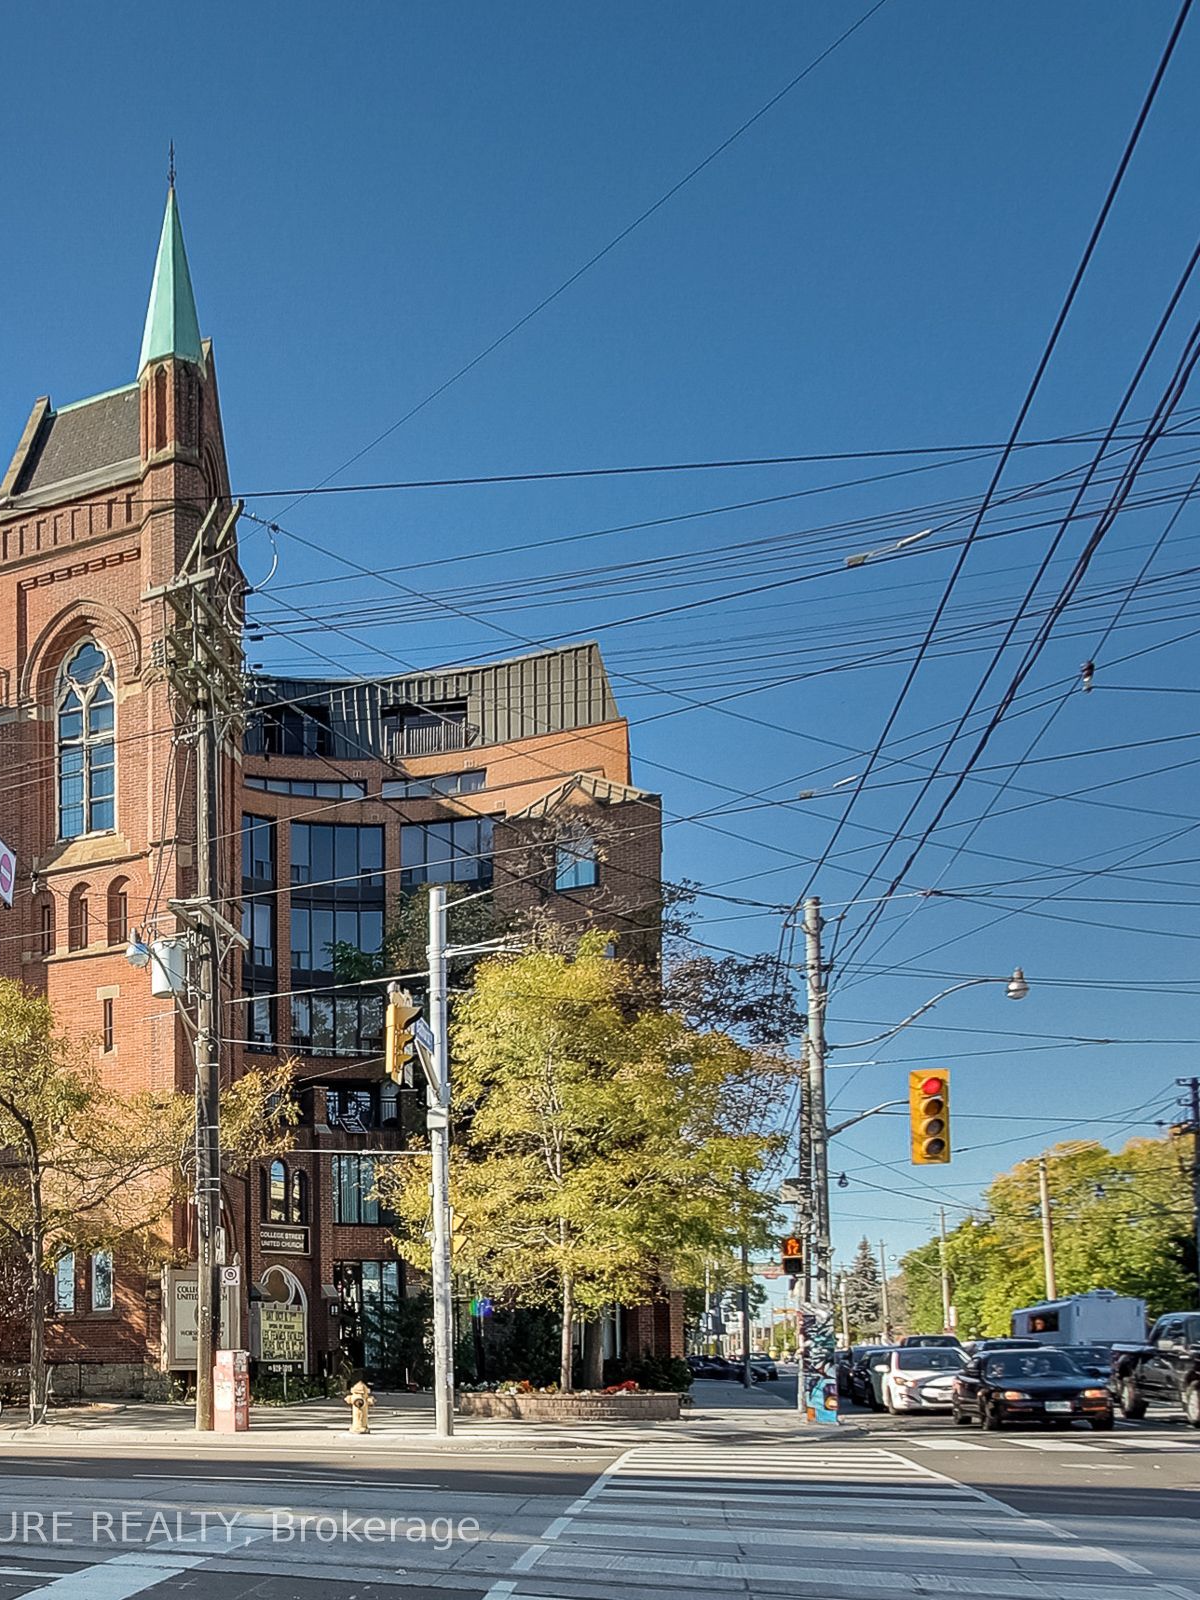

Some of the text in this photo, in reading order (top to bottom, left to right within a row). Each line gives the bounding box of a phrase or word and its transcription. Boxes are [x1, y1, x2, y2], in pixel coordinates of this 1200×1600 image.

[260, 1231, 304, 1240] COLLEGE STREET
[281, 1241, 304, 1249] CHURCH
[177, 1285, 198, 1294] COLLE
